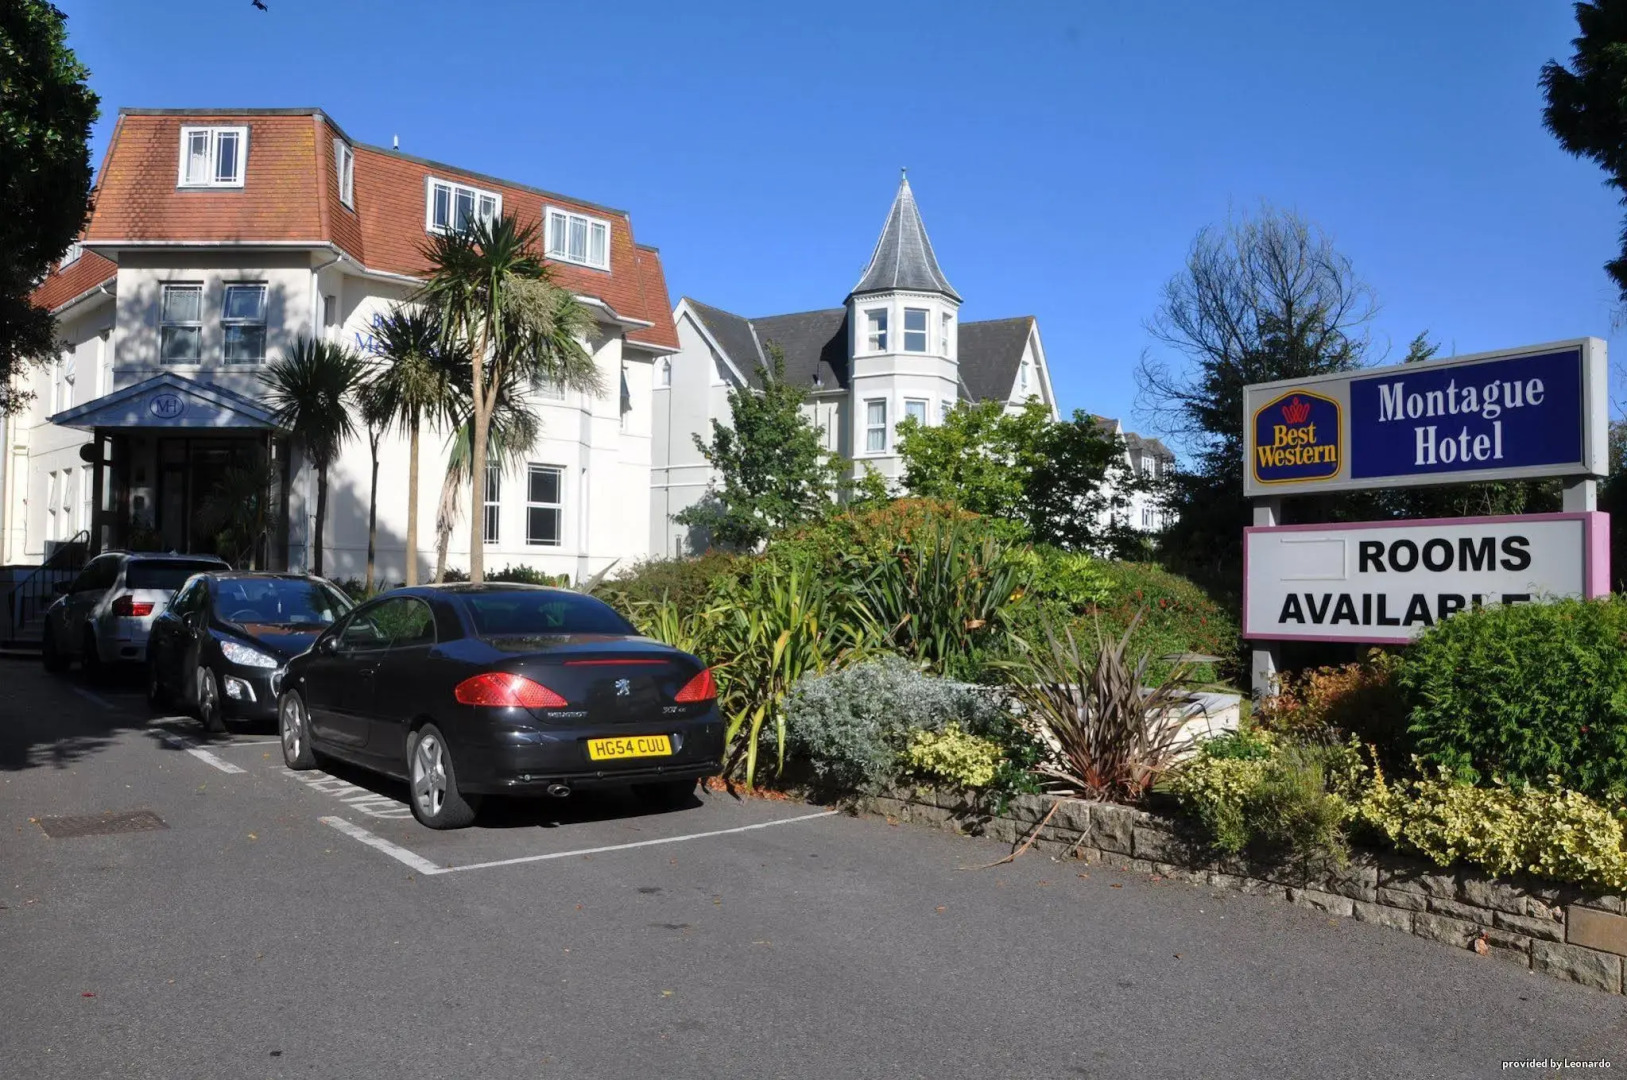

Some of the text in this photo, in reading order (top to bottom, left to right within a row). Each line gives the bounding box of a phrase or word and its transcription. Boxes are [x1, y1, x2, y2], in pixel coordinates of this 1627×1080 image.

[1378, 377, 1545, 419] Montague
[1273, 421, 1317, 447] Best
[1414, 421, 1503, 465] Hotel
[1257, 443, 1336, 468] Western
[1358, 535, 1532, 573] ROOMS
[1278, 593, 1531, 627] AVAILAB
[595, 738, 665, 756] HG54 CUU
